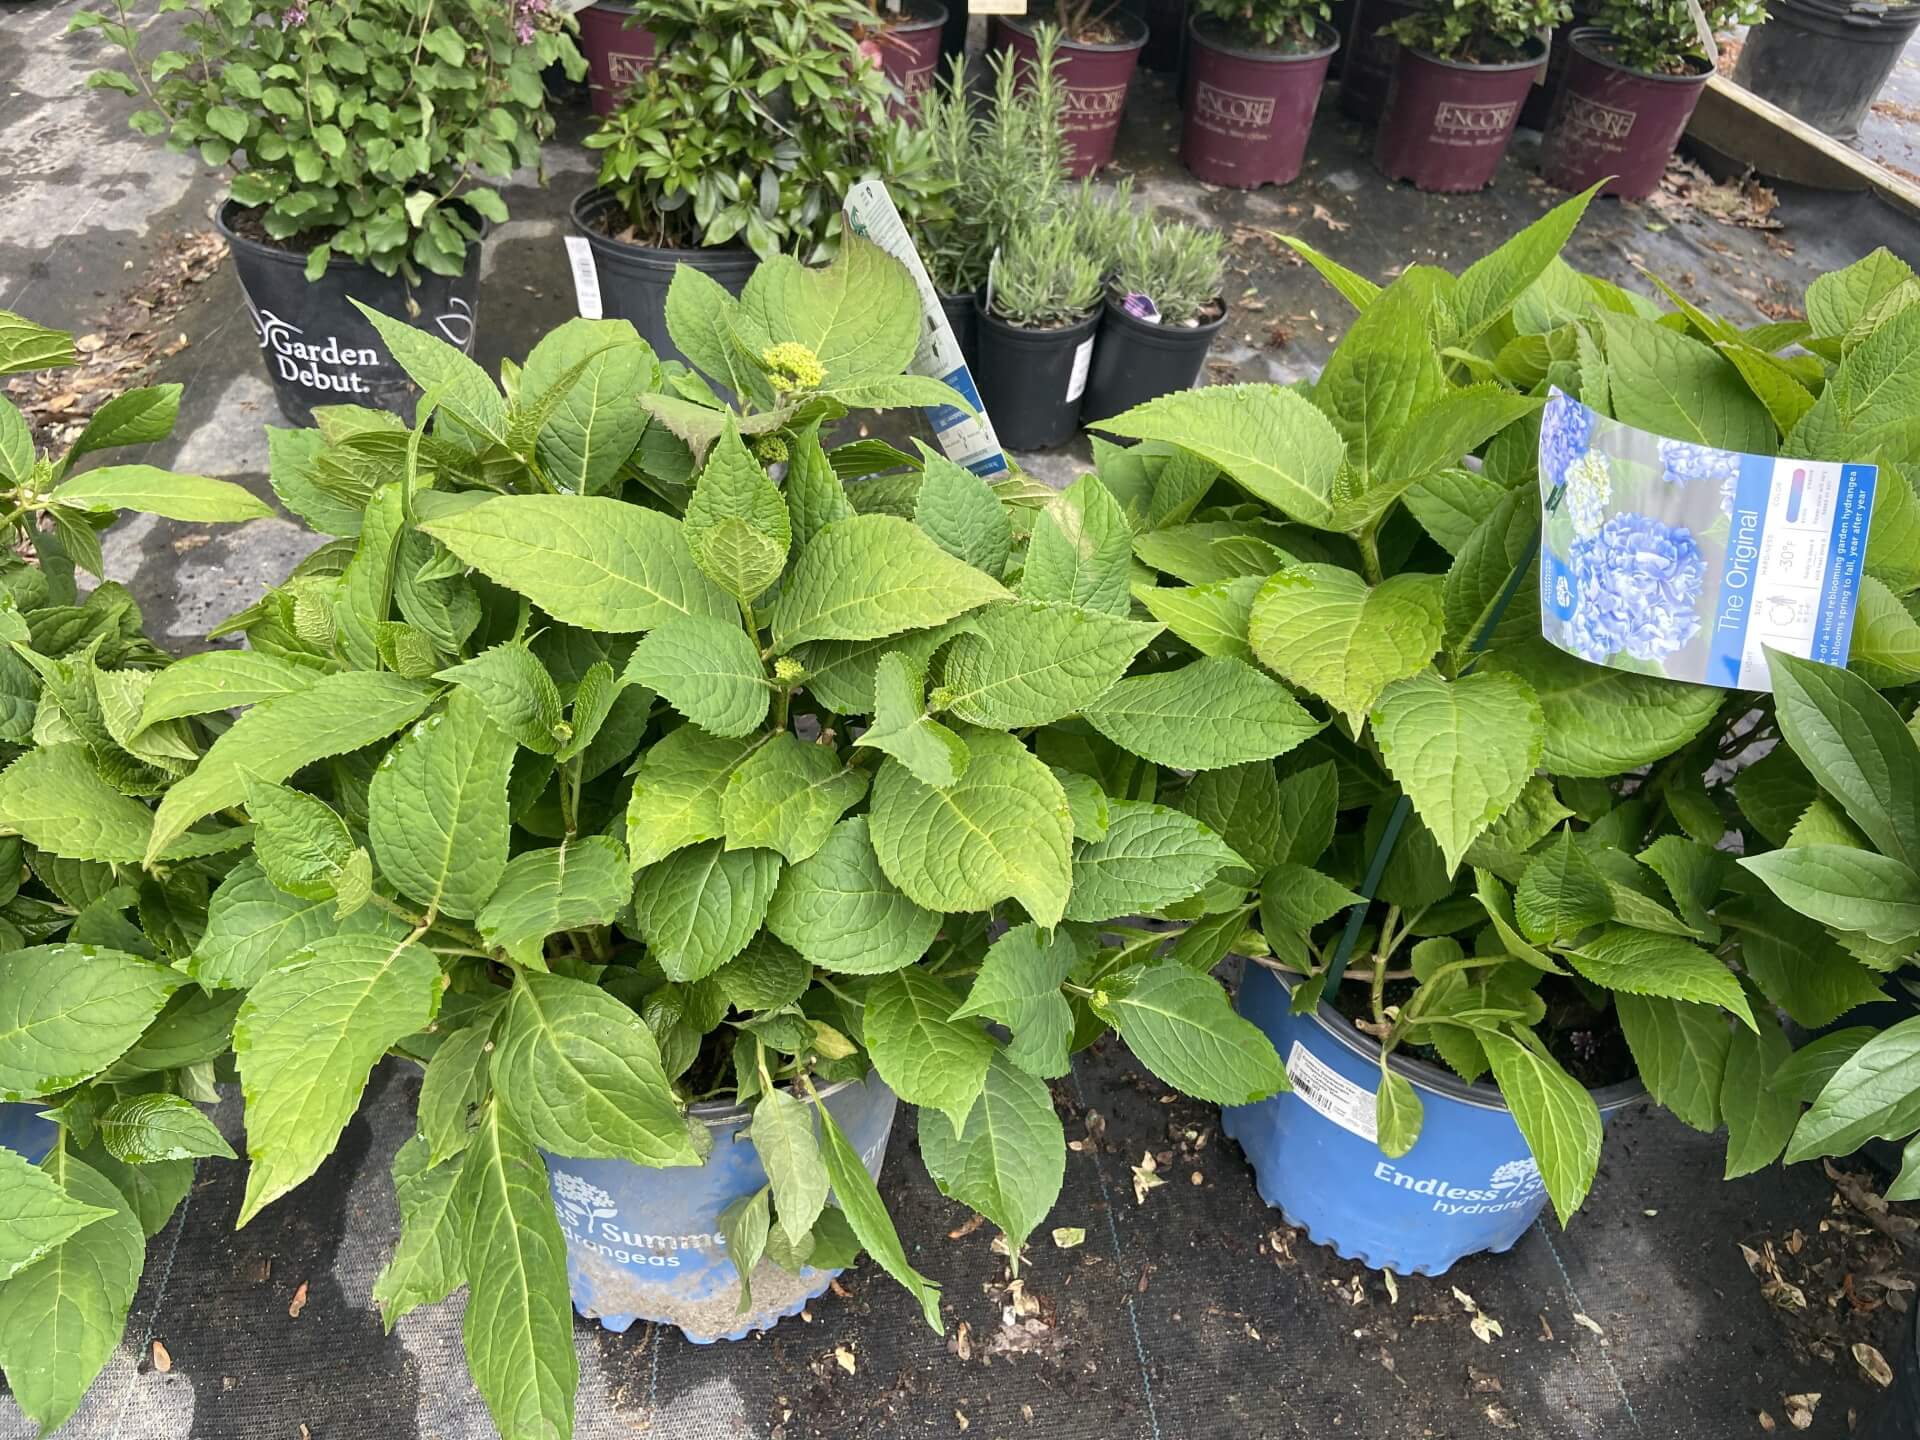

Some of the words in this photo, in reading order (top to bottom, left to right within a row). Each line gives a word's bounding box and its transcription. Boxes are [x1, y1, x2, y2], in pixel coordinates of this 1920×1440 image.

[1200, 84, 1274, 126] ENCORE
[1438, 105, 1513, 129] ENCORE
[270, 327, 380, 366] Garden
[1841, 471, 1857, 520] hydrangea
[1857, 490, 1867, 510] year
[1838, 521, 1849, 554] garden
[1852, 512, 1863, 534] after
[1726, 509, 1759, 589] Original
[1849, 537, 1858, 556] year
[1827, 557, 1845, 609] reblooming
[1844, 578, 1852, 588] to
[1717, 595, 1744, 633] The
[1839, 590, 1852, 619] spring
[1832, 622, 1845, 655] blooms
[1374, 1162, 1500, 1201] Endless
[561, 1225, 681, 1267] drangeas
[601, 1222, 727, 1250] Summe
